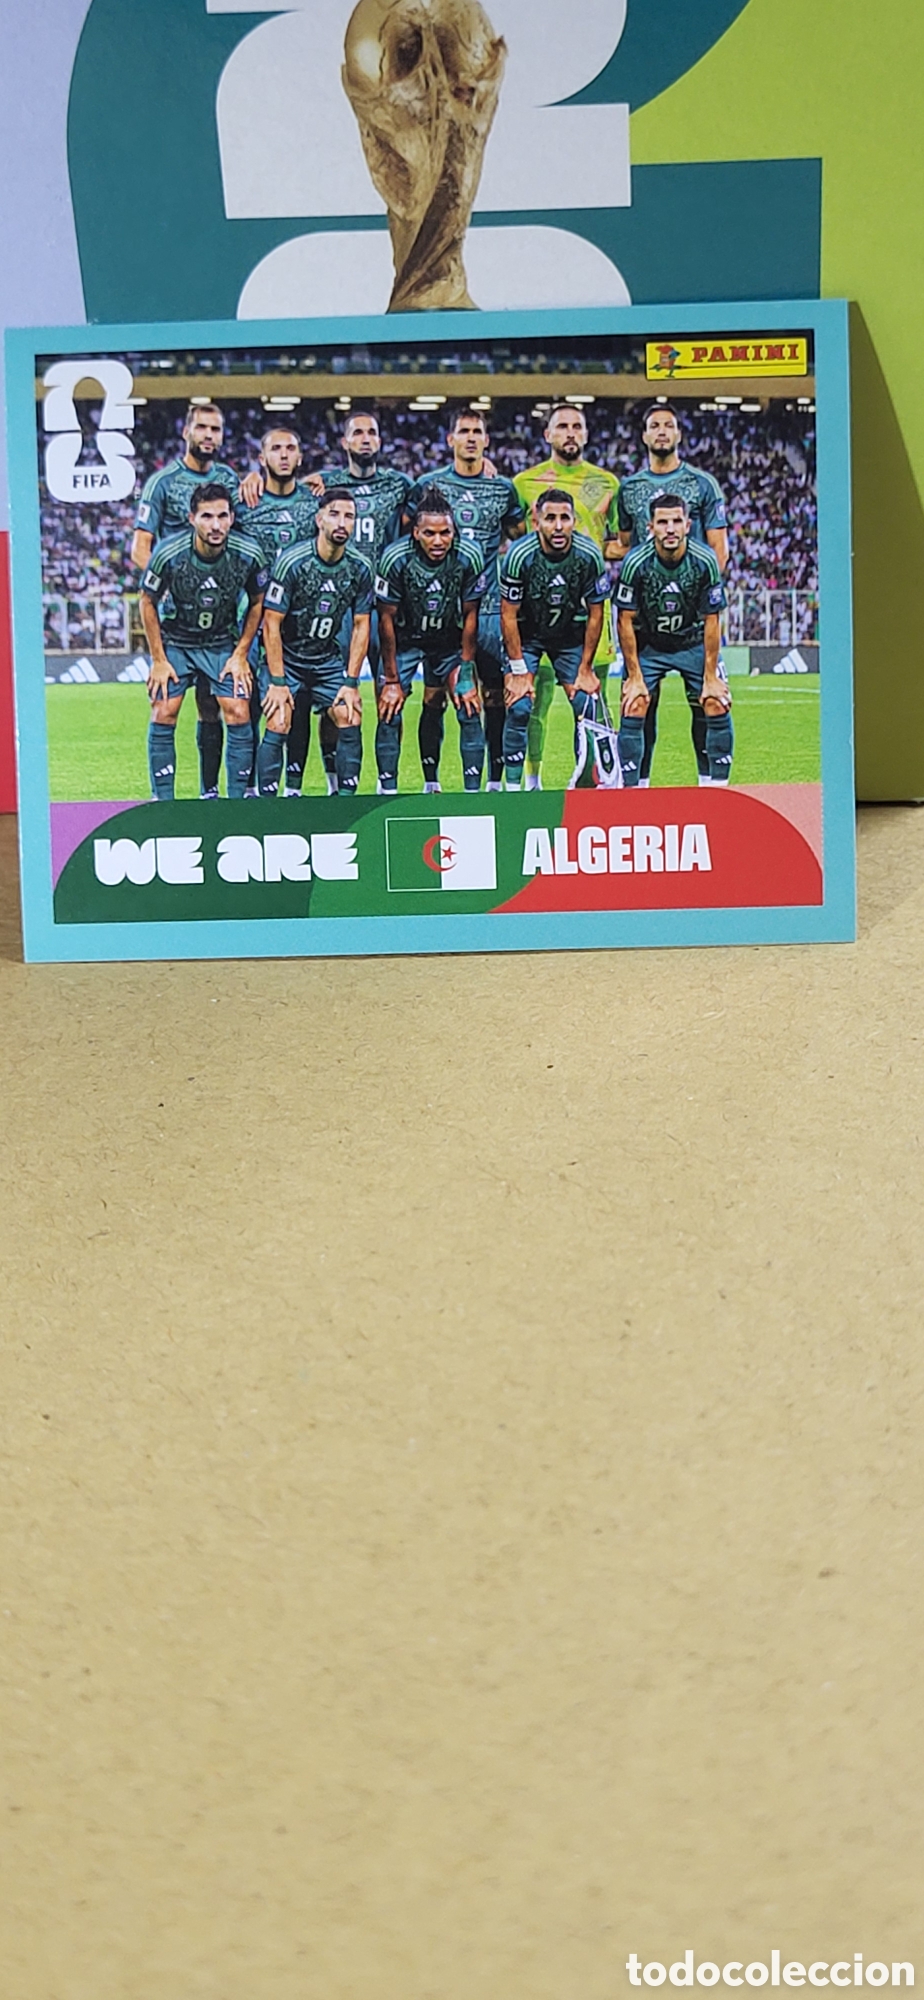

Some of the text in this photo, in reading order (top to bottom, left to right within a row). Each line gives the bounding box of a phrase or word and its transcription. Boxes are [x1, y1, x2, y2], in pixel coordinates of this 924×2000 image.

[691, 344, 800, 363] PANINI
[72, 474, 112, 489] FIFA
[355, 517, 375, 543] 19
[198, 611, 213, 630] 8
[421, 615, 443, 632] 14
[549, 608, 562, 627] 7
[657, 614, 684, 635] 20
[308, 616, 334, 639] 18
[93, 836, 205, 886] WE
[522, 823, 713, 876] ALGERIA
